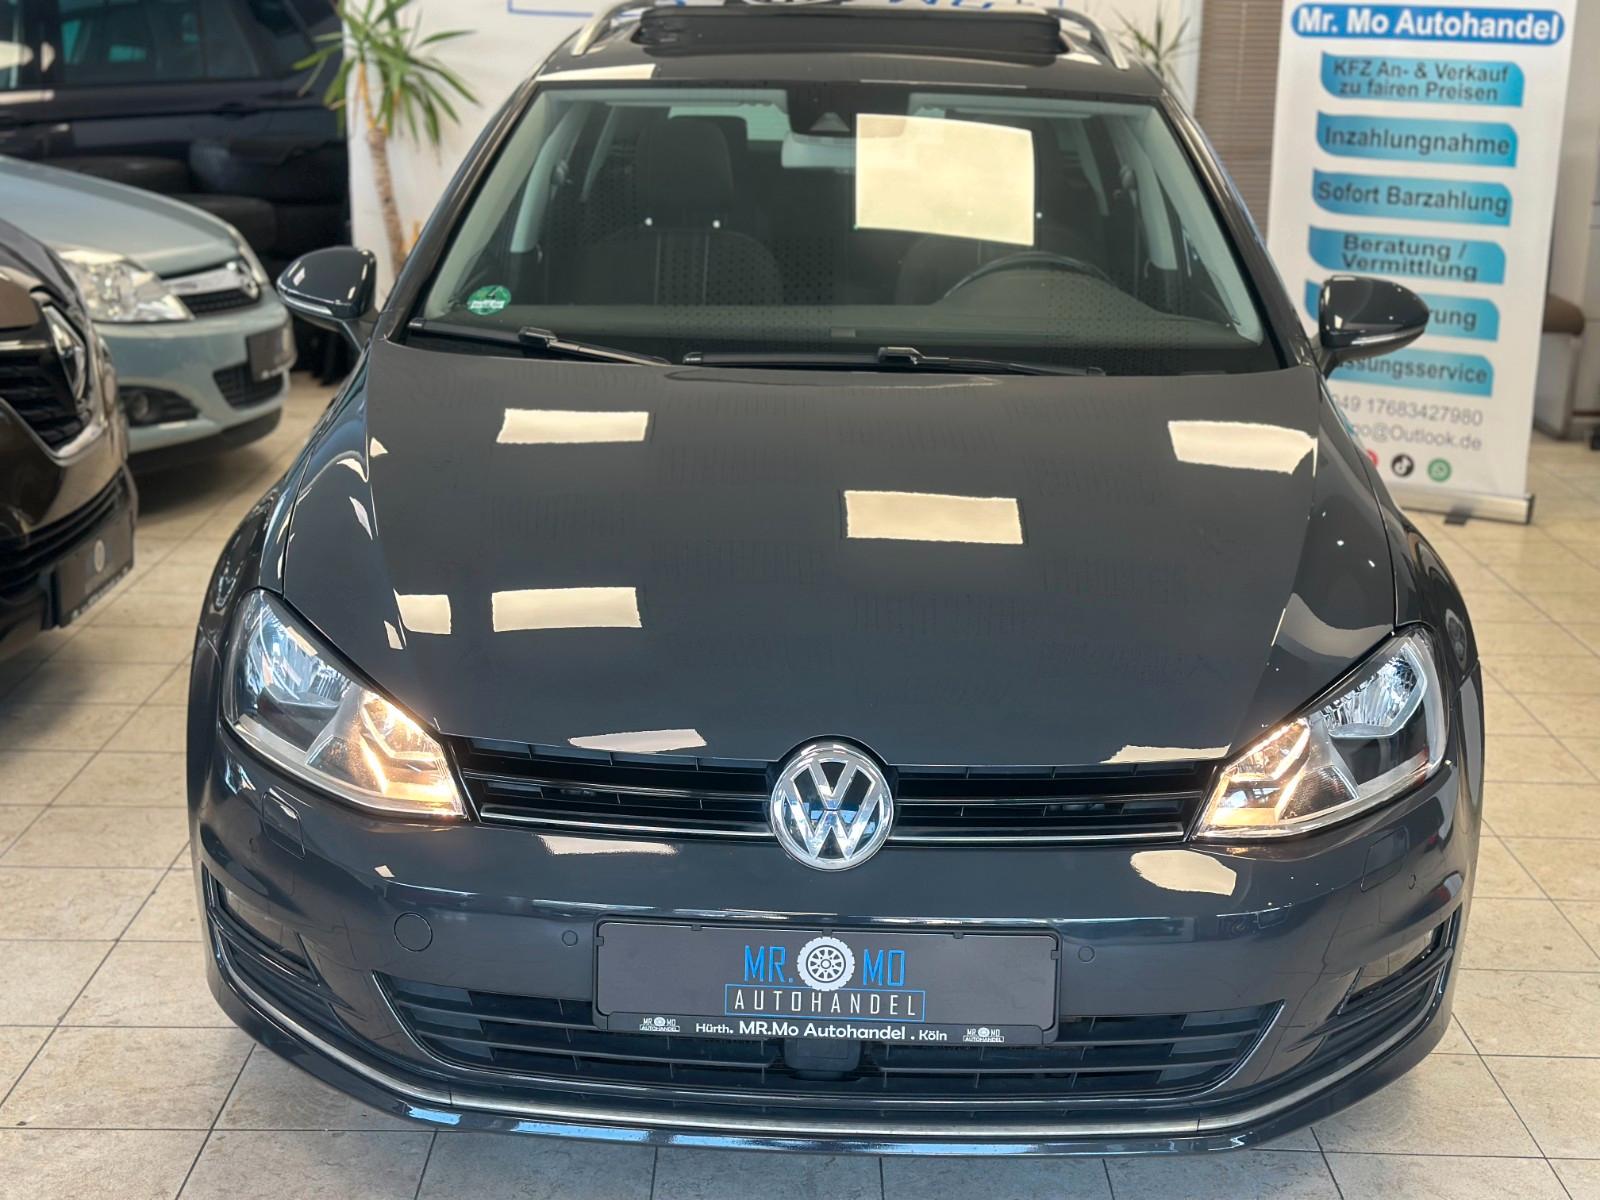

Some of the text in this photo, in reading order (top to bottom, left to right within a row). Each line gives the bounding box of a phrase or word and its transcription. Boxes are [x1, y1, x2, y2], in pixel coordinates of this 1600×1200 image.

[1298, 7, 1560, 41] Mr. Mo Autohandel
[1333, 60, 1508, 83] KFZ An- & Verkauf
[1339, 78, 1498, 101] zu fairen Preisen
[1324, 126, 1511, 156] Inzahlungnahme
[1318, 181, 1508, 217] Sofort Barzahlung
[1343, 234, 1451, 263] Beratung
[1342, 253, 1478, 283] Vermittlung
[1427, 308, 1477, 333] rung
[743, 945, 905, 987] MR. MO
[734, 989, 917, 1016] AUTOHANDEL
[695, 1022, 734, 1034] Hürth.
[739, 1020, 799, 1036] MR.Mo
[804, 1022, 906, 1041] Autohandel
[919, 1029, 948, 1041] Köln
